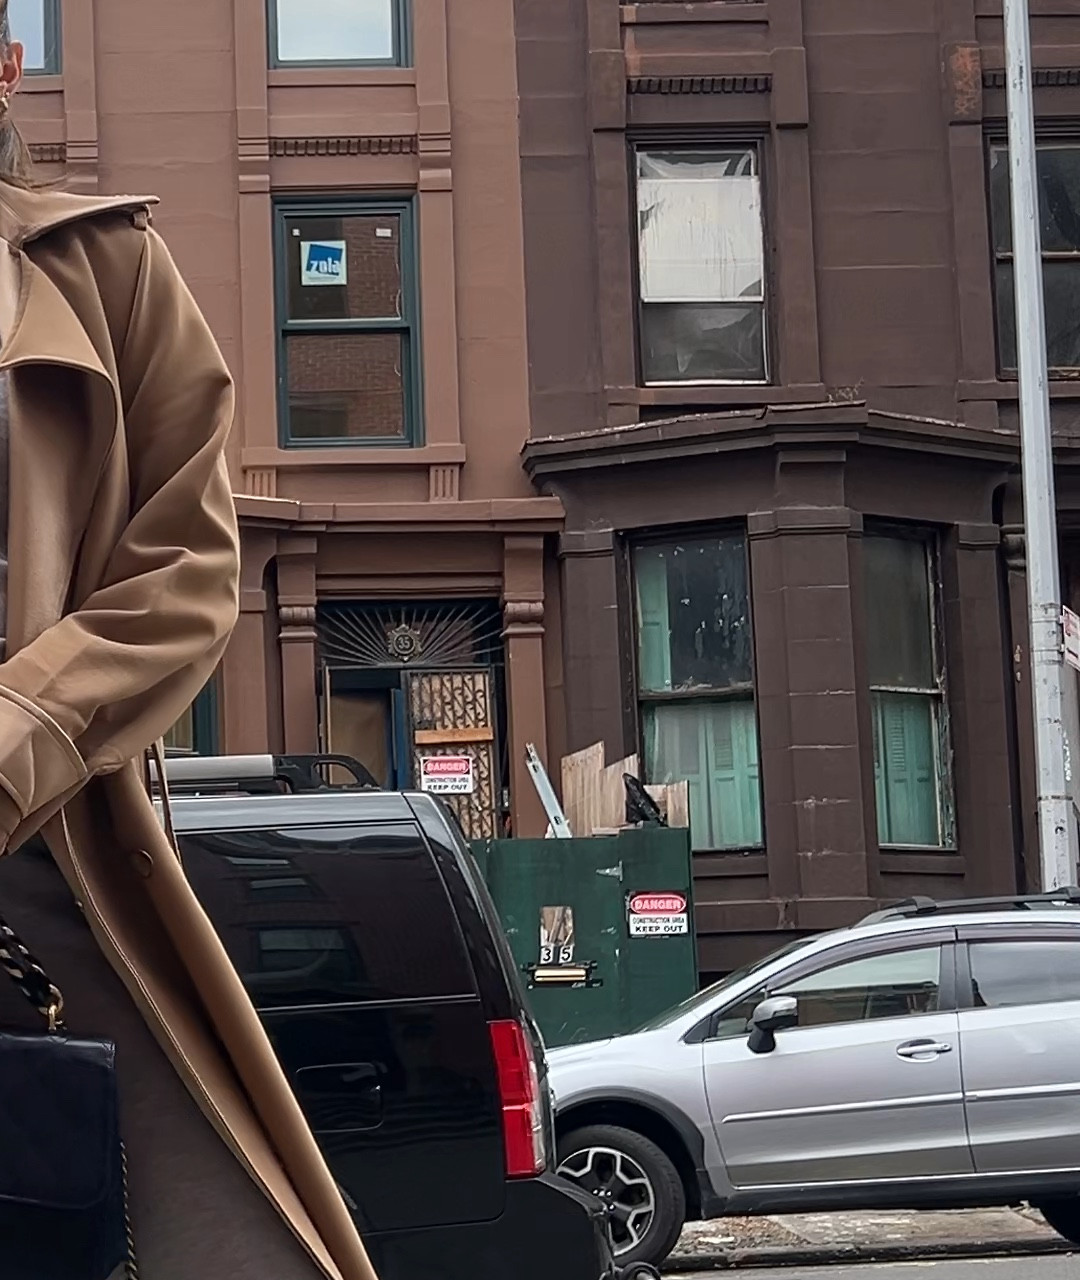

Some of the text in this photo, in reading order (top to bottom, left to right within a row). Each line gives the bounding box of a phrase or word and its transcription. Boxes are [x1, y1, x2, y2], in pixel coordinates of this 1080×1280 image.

[398, 636, 410, 649] 35
[426, 762, 466, 771] DANGER
[634, 899, 682, 910] DANGER
